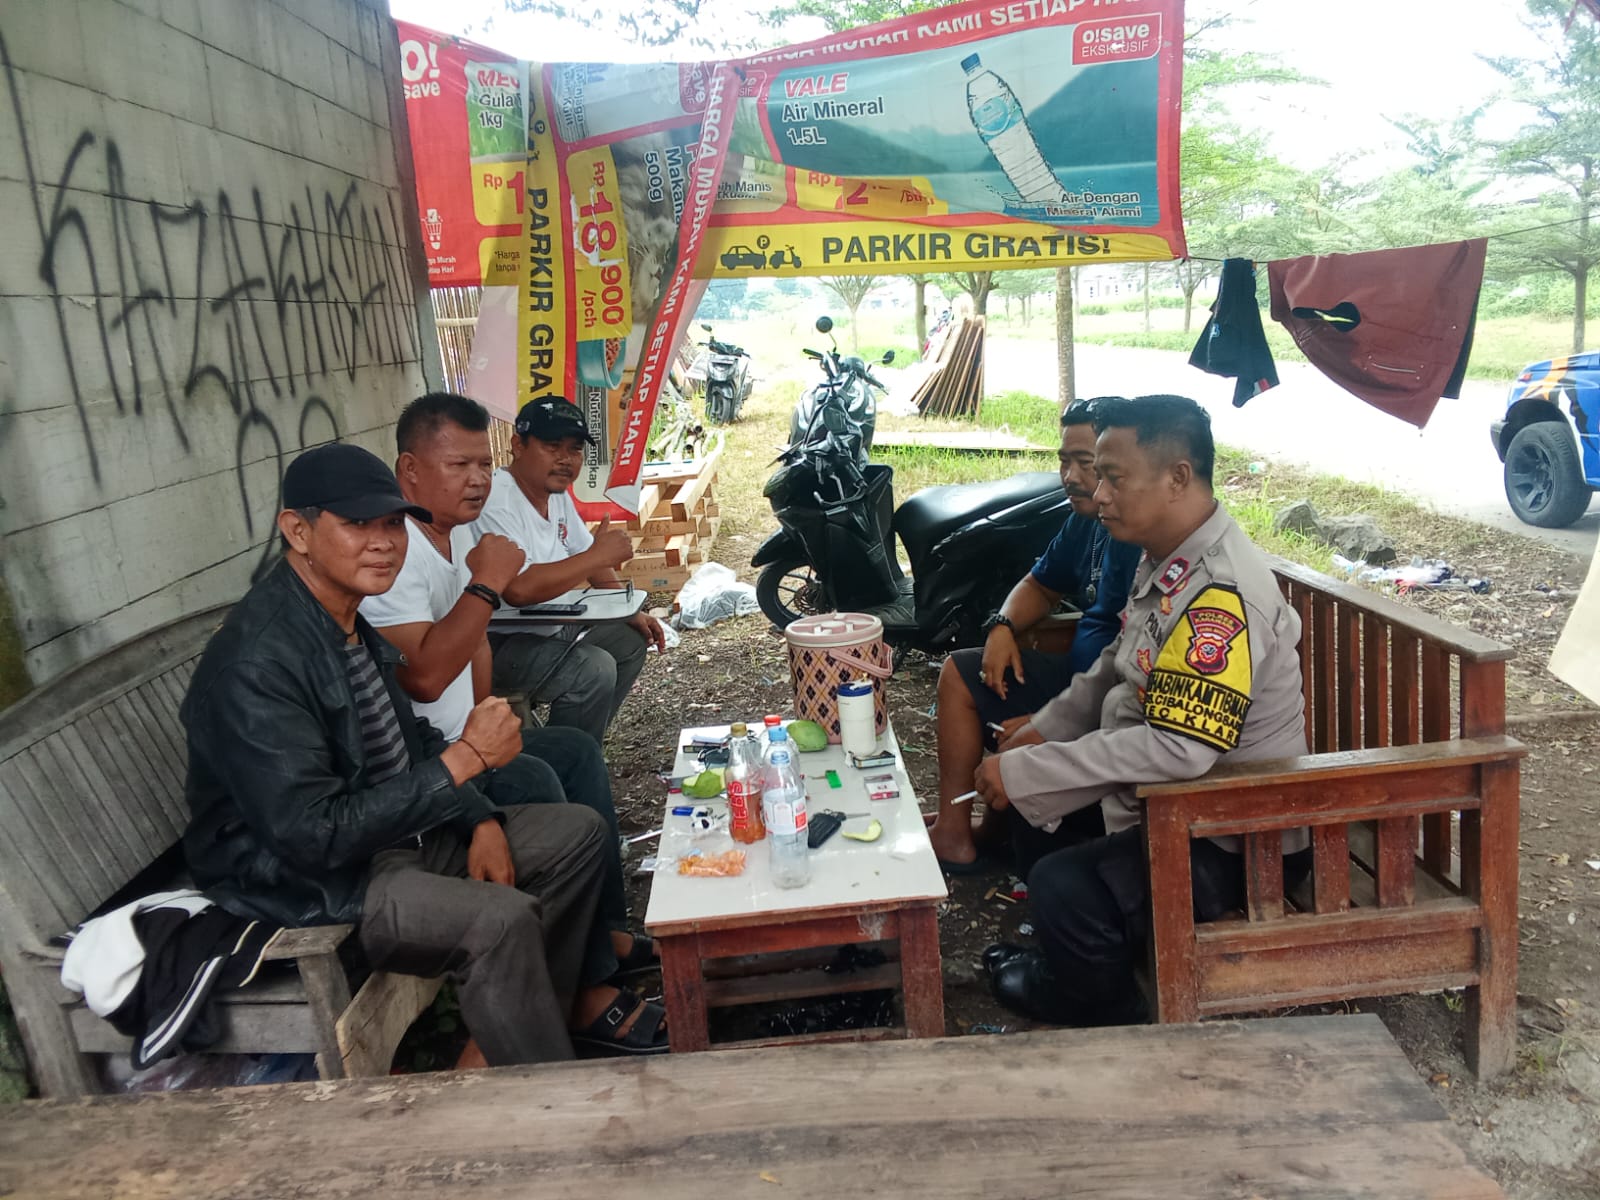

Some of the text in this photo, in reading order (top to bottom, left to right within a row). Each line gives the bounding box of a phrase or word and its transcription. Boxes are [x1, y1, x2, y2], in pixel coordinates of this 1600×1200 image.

[990, 0, 1086, 26] SETIAP
[1081, 41, 1149, 58] EKSKLUSIF
[785, 73, 848, 98] VALE
[479, 92, 514, 108] Gula
[782, 96, 884, 121] Air Mineral
[478, 111, 503, 128] 1kg
[699, 75, 725, 161] HARGA
[787, 127, 828, 145] 1.5L
[483, 173, 503, 190] Rp
[594, 161, 605, 187] Rp
[645, 151, 664, 203] 500g
[808, 172, 831, 185] Rp
[735, 181, 772, 193] Manis
[1061, 192, 1139, 205] Air Dengan
[1046, 206, 1141, 217] Mineral Alami
[822, 232, 1112, 264] PARKIR GRATIS!
[528, 188, 555, 396] PARKIR GRA
[581, 290, 598, 329] /pch
[637, 320, 669, 403] SETIAP
[590, 391, 601, 434] Nutrisi
[619, 410, 644, 466] HARI
